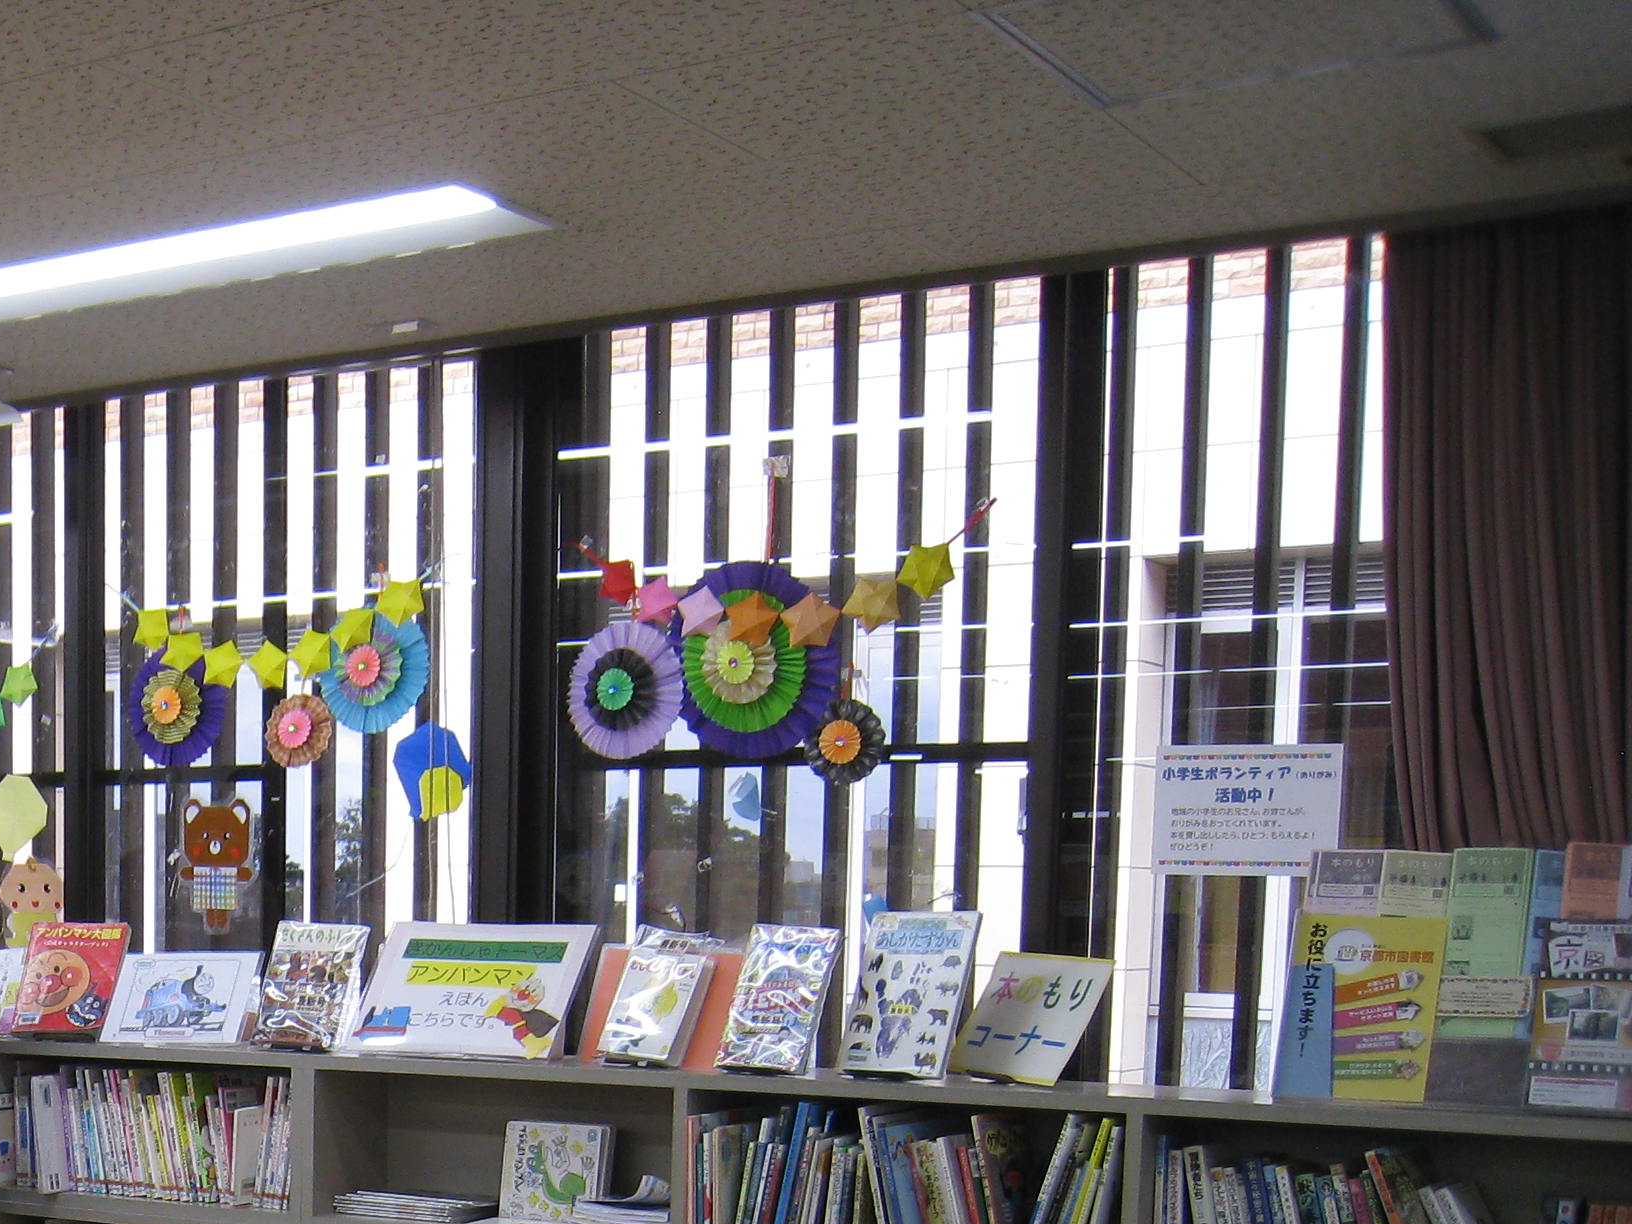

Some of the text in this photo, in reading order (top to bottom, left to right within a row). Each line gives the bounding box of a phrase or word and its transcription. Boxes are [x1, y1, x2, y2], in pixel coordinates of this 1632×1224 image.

[1162, 766, 1292, 781] 小学生ボランティア
[1215, 788, 1275, 803] 活動中！
[405, 940, 567, 960] きかんしゃトーマス
[407, 965, 534, 986] アンパンマン
[438, 990, 489, 1008] えほん
[991, 972, 1093, 1012] 本のもり
[1298, 923, 1328, 1057] お役に立ちます！
[409, 1011, 499, 1030] こちらです。
[968, 1025, 1066, 1055] コーナー
